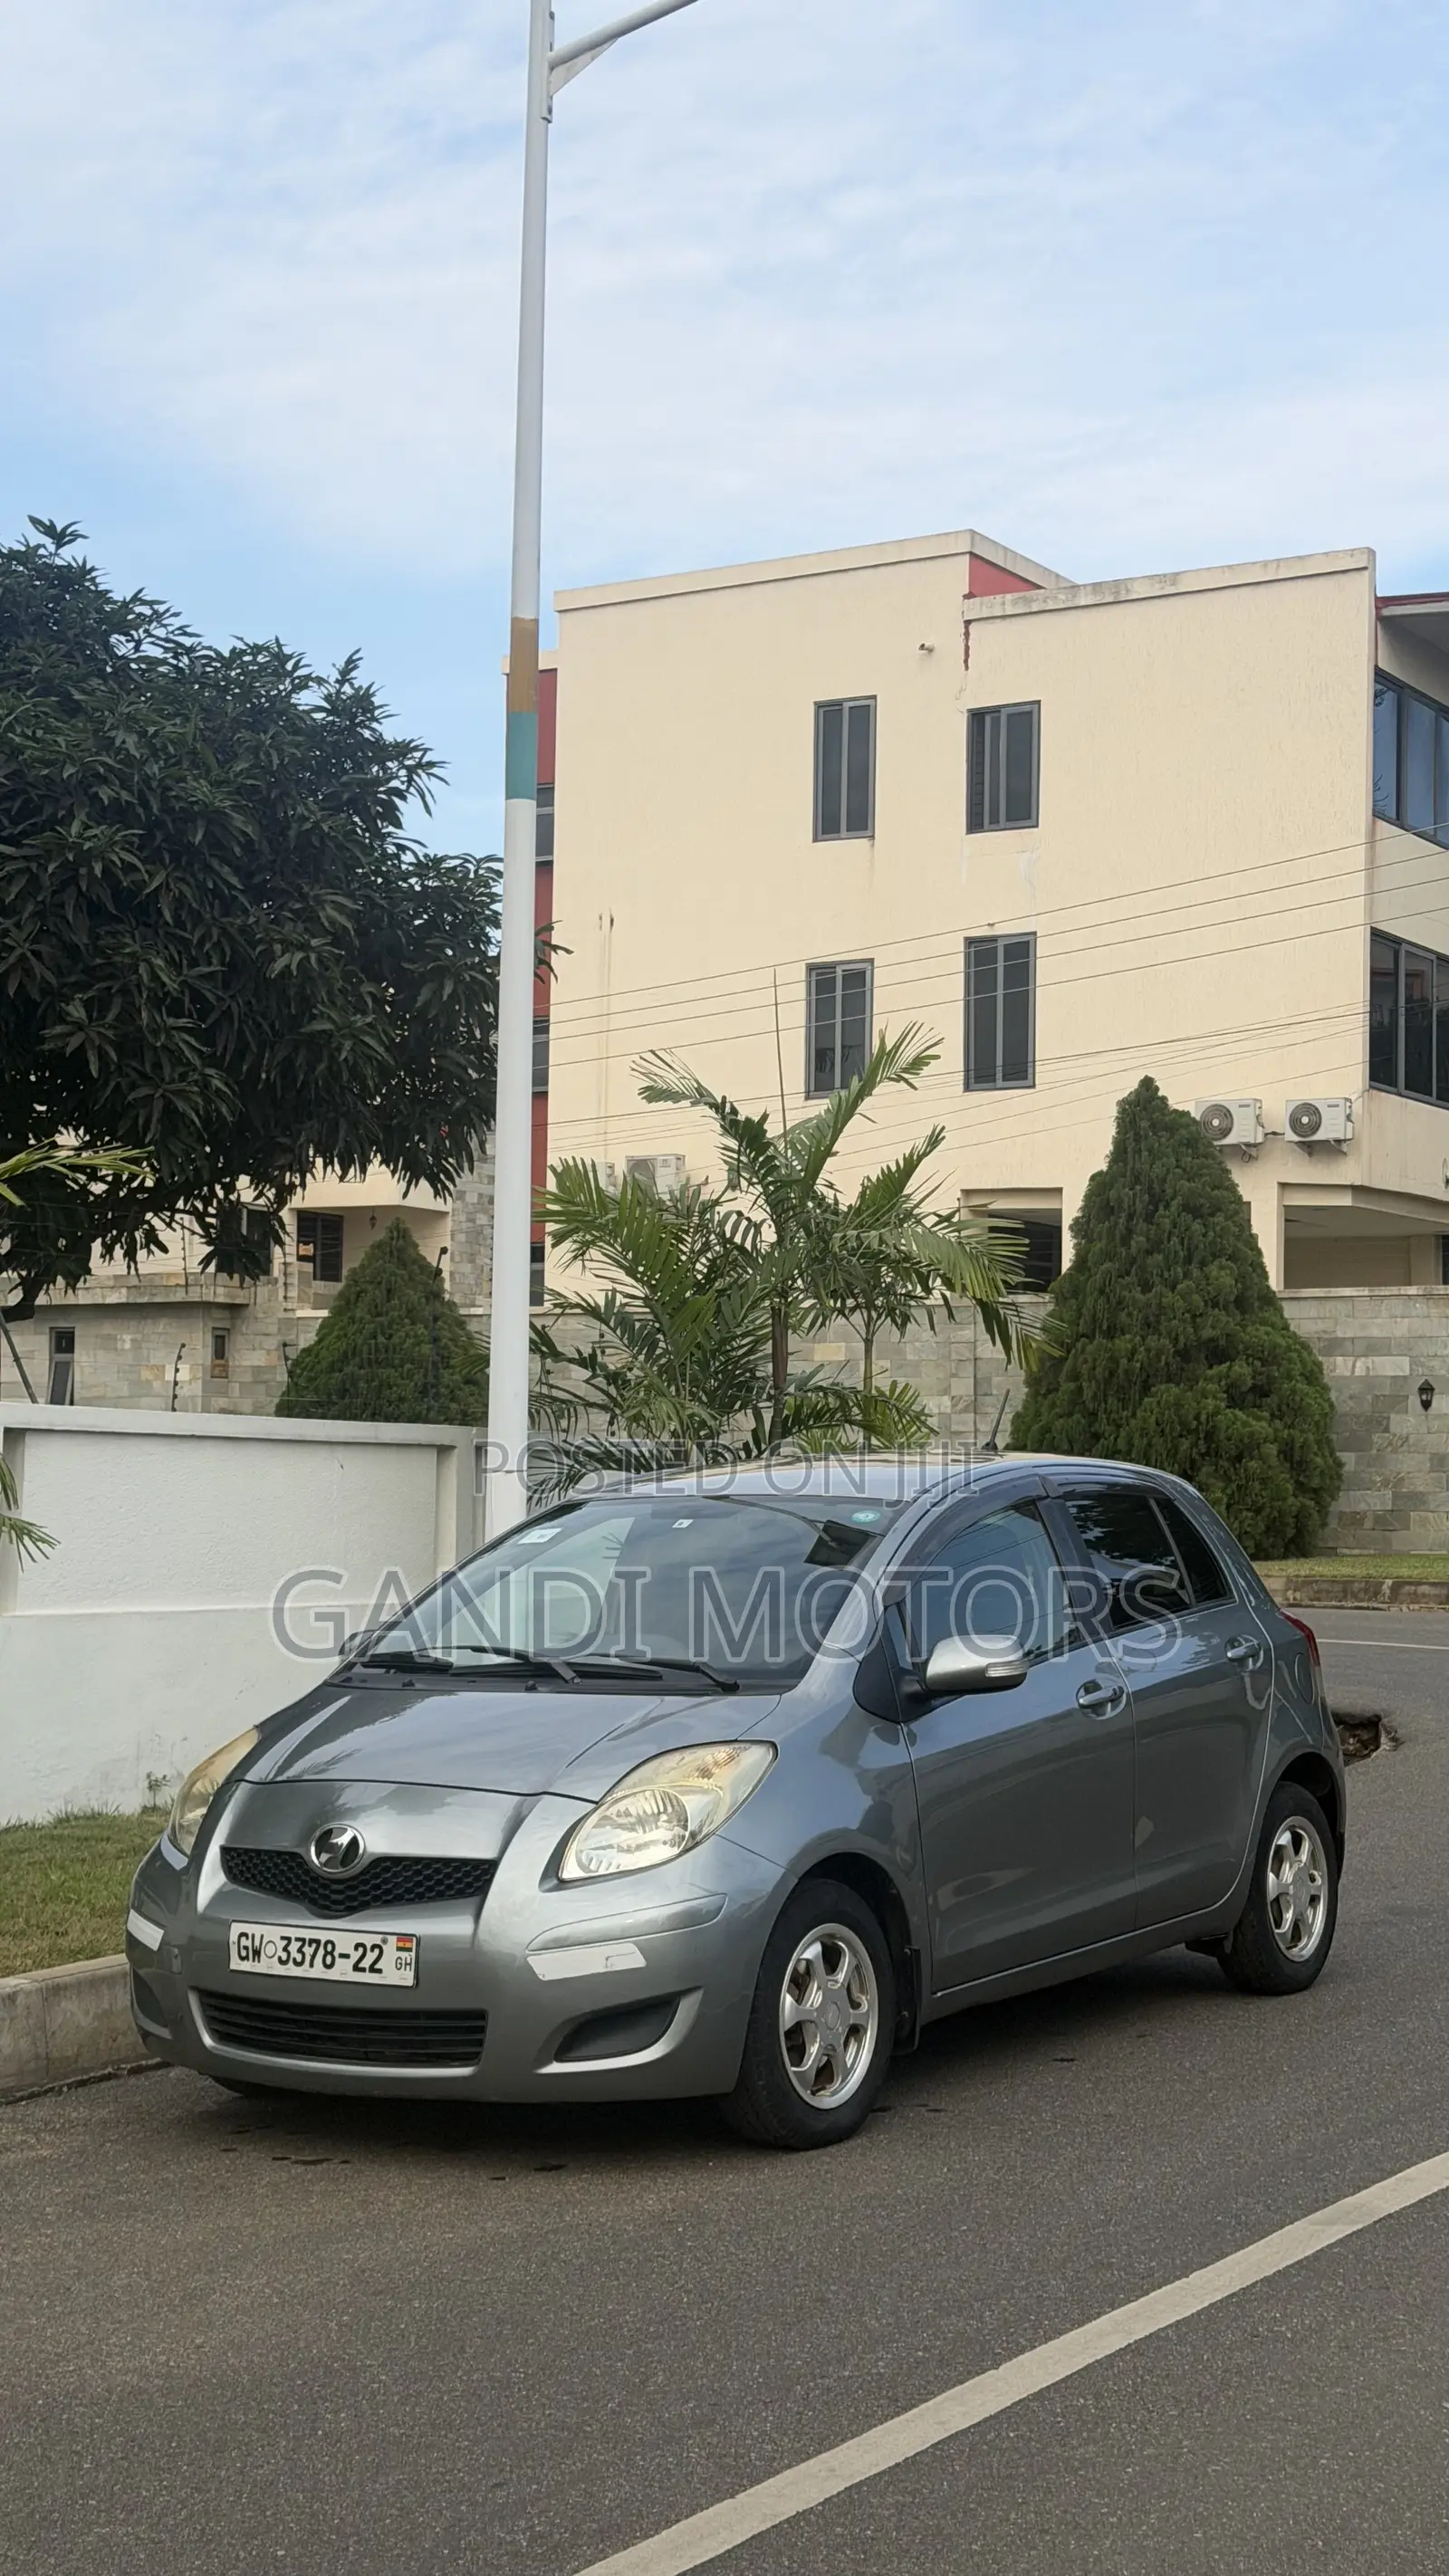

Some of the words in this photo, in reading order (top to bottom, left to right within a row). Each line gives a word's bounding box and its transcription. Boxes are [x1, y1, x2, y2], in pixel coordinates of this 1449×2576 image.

[236, 1931, 264, 1964] GW
[277, 1935, 384, 1974] 3378-22
[395, 1956, 413, 1972] GH
